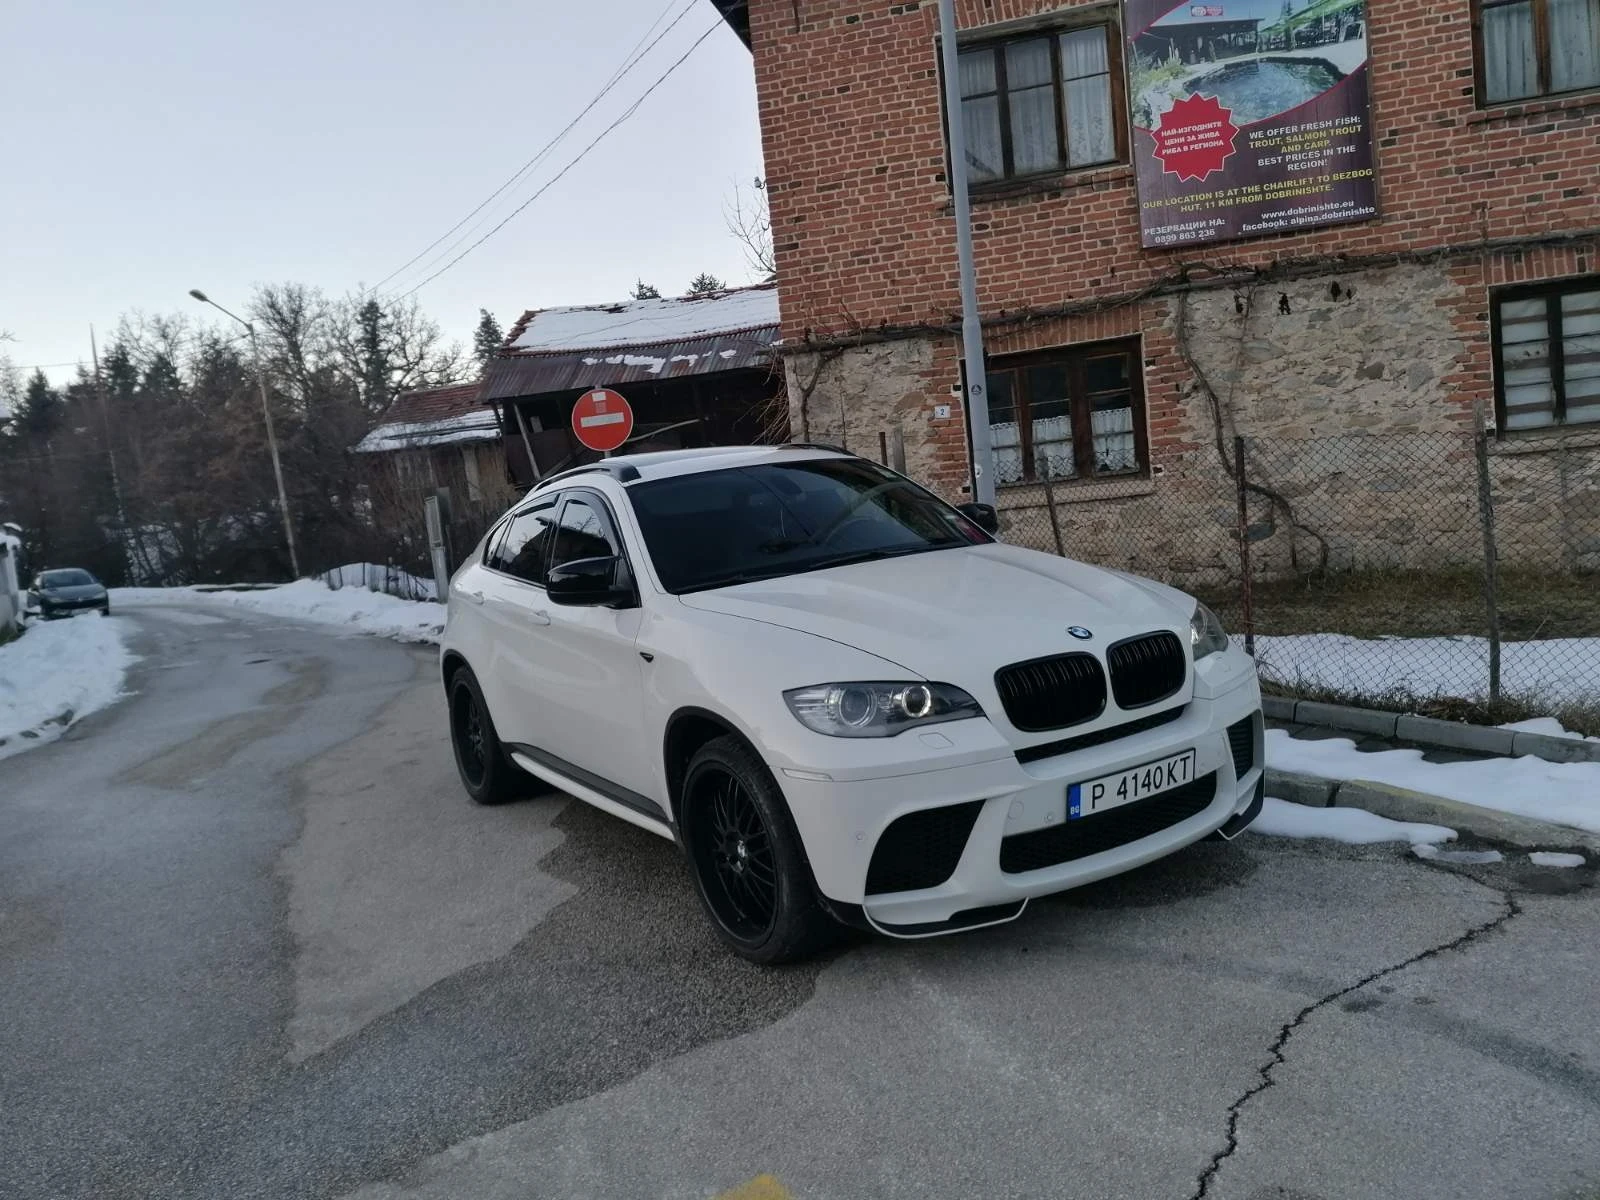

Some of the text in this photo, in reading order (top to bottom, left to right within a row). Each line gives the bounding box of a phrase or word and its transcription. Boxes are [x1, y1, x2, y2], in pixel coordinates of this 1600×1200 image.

[1161, 121, 1222, 136] НАЙ-ИЗГОДНИТЕ
[1249, 116, 1360, 139] WE OFFER FRESH FISH:
[1286, 131, 1326, 143] SALMON
[1330, 125, 1362, 136] TROUT
[1165, 137, 1185, 145] ЦЕНИ
[1198, 131, 1220, 139] ЖИВА
[1162, 147, 1181, 155] РИБА
[1190, 140, 1224, 150] РЕГИОНА
[1258, 157, 1282, 166] BEST
[1286, 151, 1320, 162] PRICES
[1336, 145, 1356, 154] THE
[1281, 144, 1300, 153] AND
[1287, 159, 1327, 171] REGION!
[1143, 169, 1372, 209] OUR LOCATION IS AT THE CHAIRLIFT TO BEZBOG
[1218, 199, 1233, 207] KM
[1235, 194, 1262, 204] FROM
[1265, 184, 1334, 200] DOBRINISHTE.
[1261, 200, 1354, 219] www.dobrinishte.eu
[1144, 218, 1225, 235] РЕЗЕРВАЦИИ НА:
[1242, 206, 1375, 231] facebook: alpina.dobrinishte
[1155, 234, 1177, 244] 0899
[1179, 231, 1195, 240] 863
[1092, 783, 1105, 809] P
[1070, 805, 1080, 815] BG
